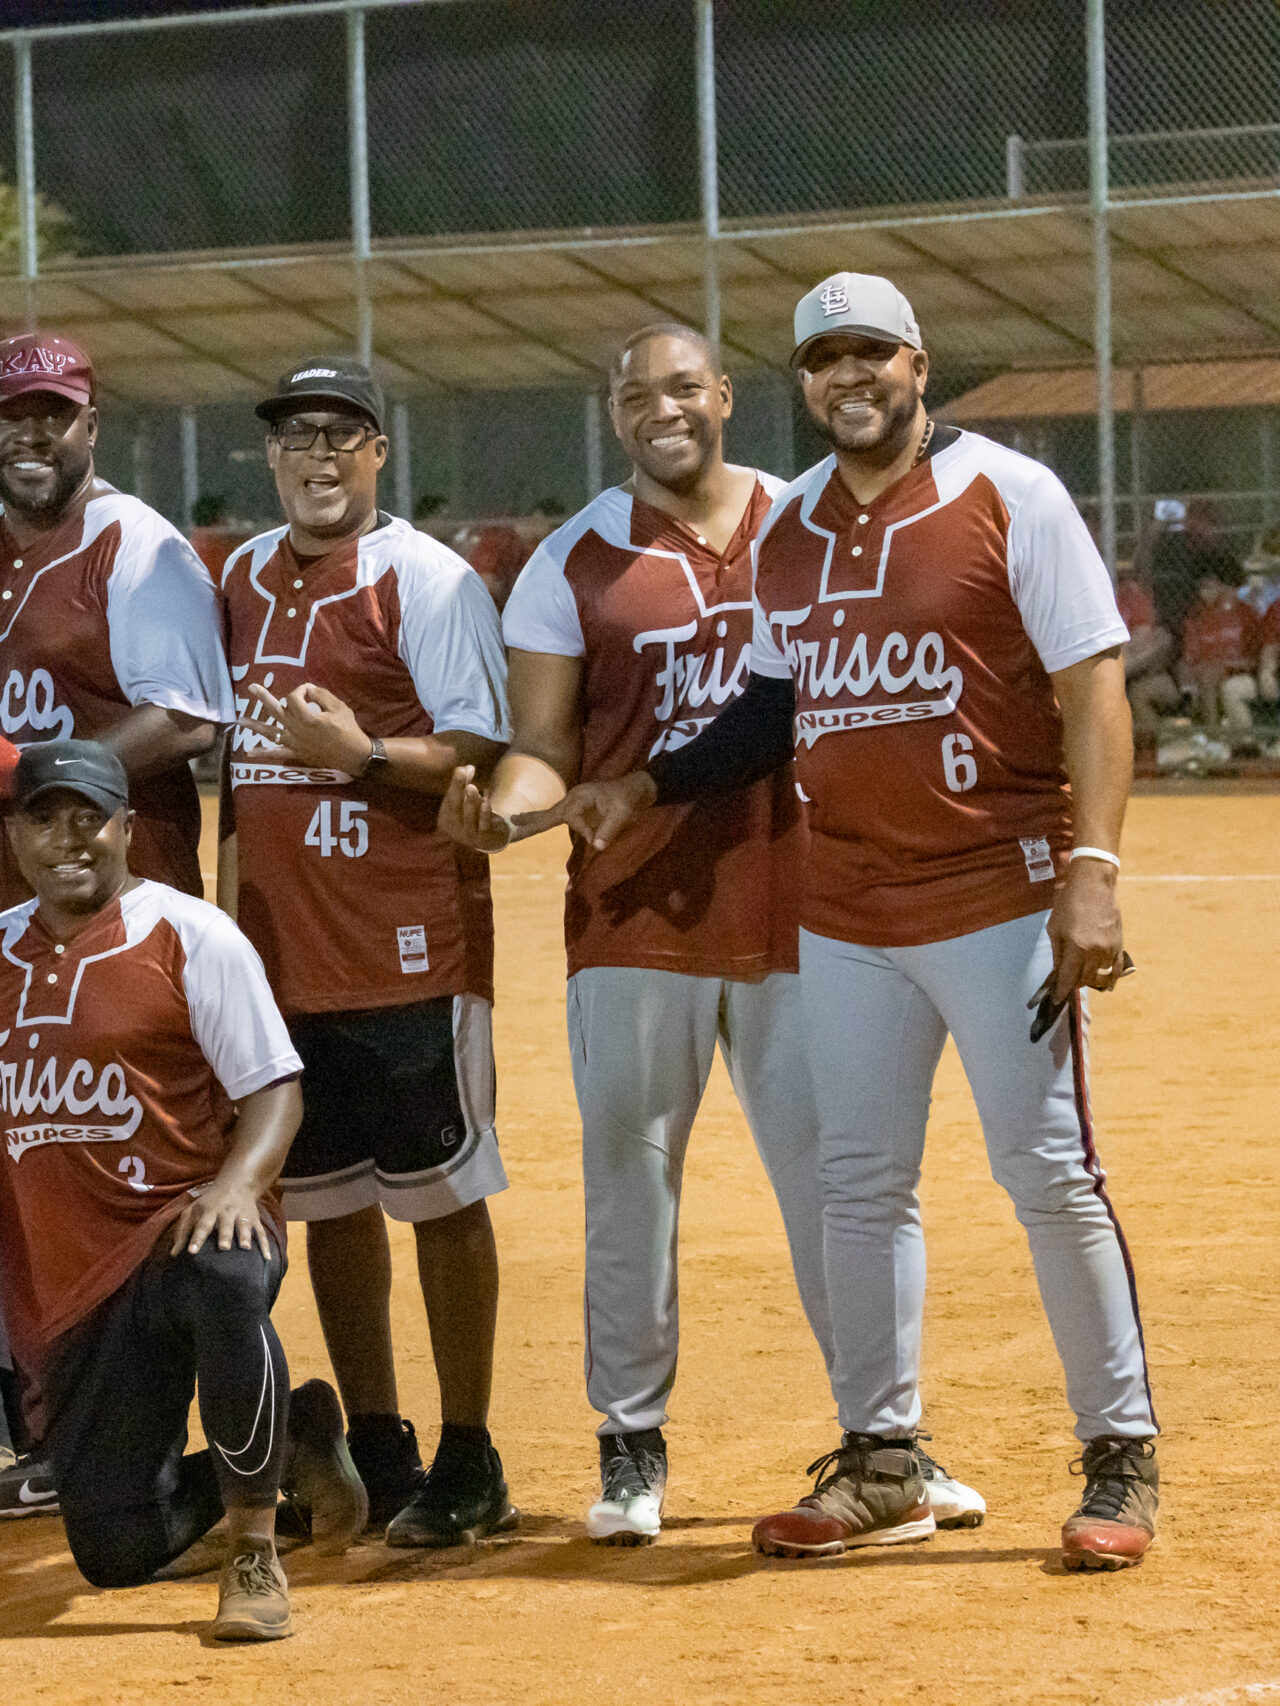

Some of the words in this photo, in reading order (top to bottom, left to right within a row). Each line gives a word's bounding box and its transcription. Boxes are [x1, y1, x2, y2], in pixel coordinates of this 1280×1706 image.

[290, 368, 338, 383] LEADERS
[770, 604, 963, 700] Frisco
[799, 703, 935, 730] Nupes
[941, 733, 978, 793] 6
[231, 767, 337, 783] upes
[304, 801, 369, 858] 45
[399, 928, 423, 938] NUPE
[5, 1128, 114, 1147] Nupes
